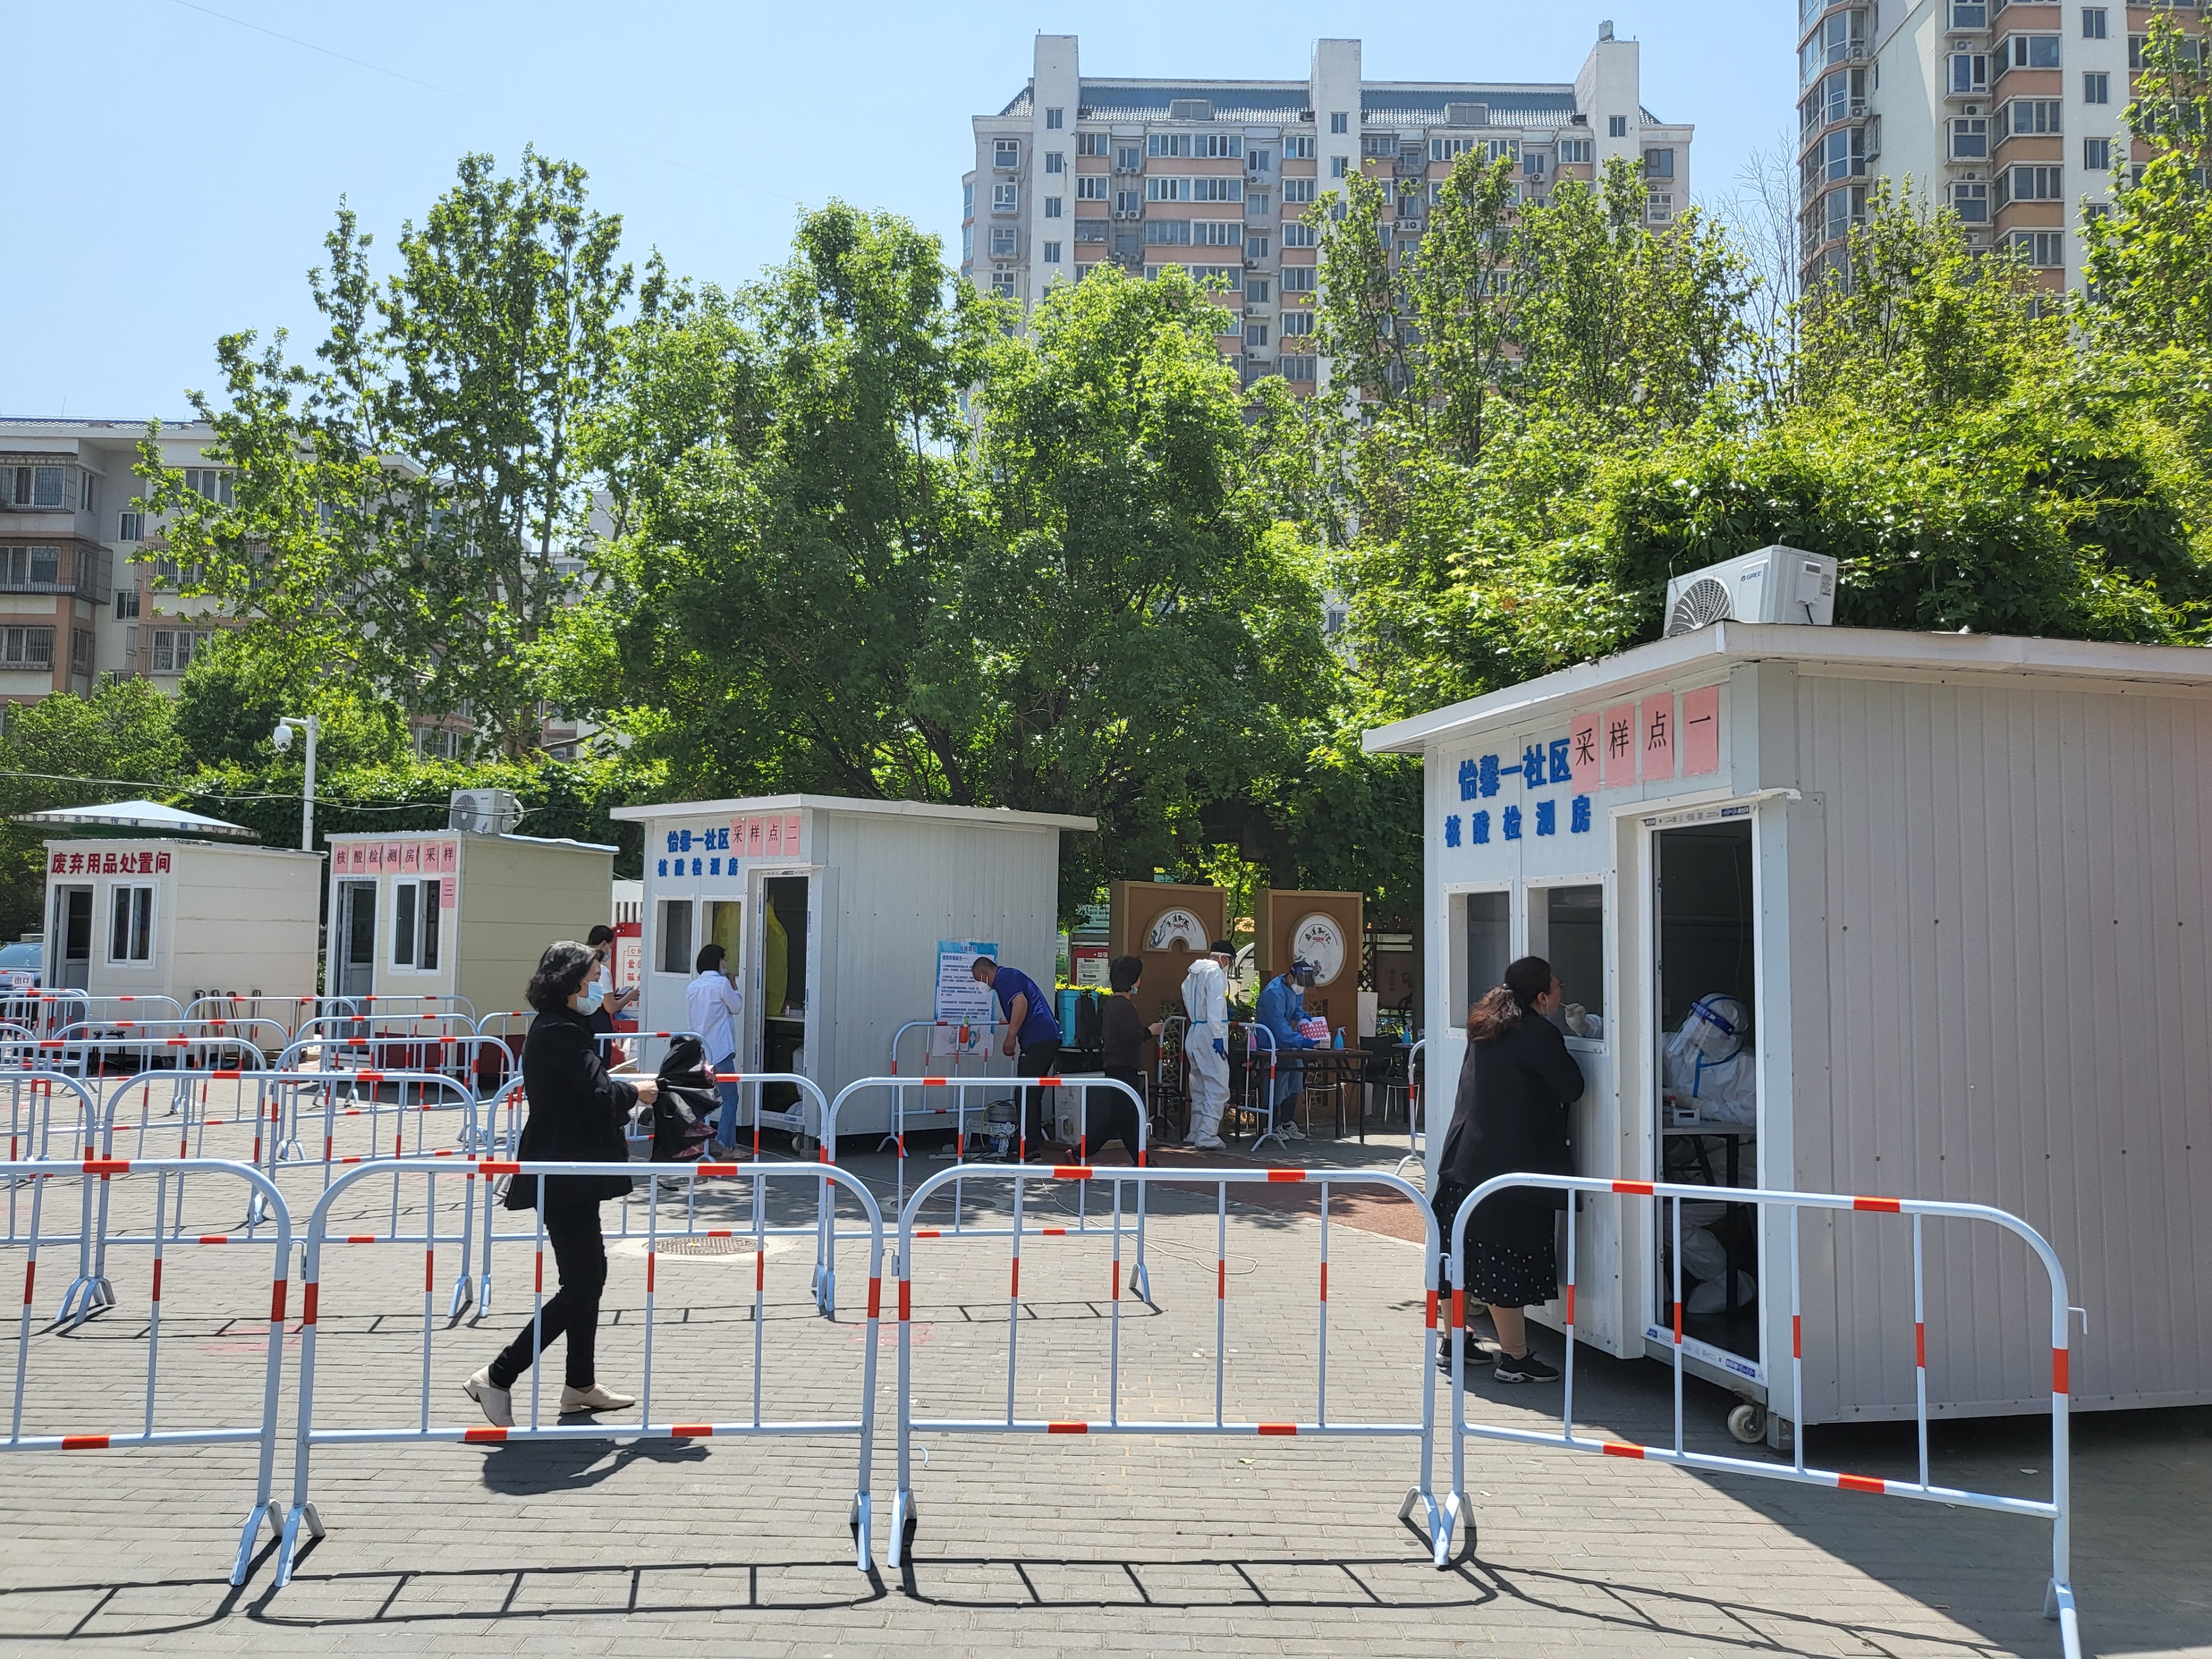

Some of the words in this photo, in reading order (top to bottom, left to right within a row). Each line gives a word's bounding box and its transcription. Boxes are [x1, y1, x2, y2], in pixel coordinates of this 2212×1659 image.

[1746, 570, 1762, 580] GREE
[1575, 711, 1711, 766] 采样点一
[1458, 738, 1572, 801] 怡馨一社区
[1445, 795, 1591, 847] 核酸检测房
[667, 828, 730, 853] 怡馨一社区
[732, 823, 797, 843] 采样点二
[51, 851, 171, 874] 废弃用品处置间
[337, 847, 454, 864] 核酸检测房采样
[658, 857, 738, 877] 核酸检测房
[444, 885, 453, 896] 三
[15, 976, 29, 984] 出口
